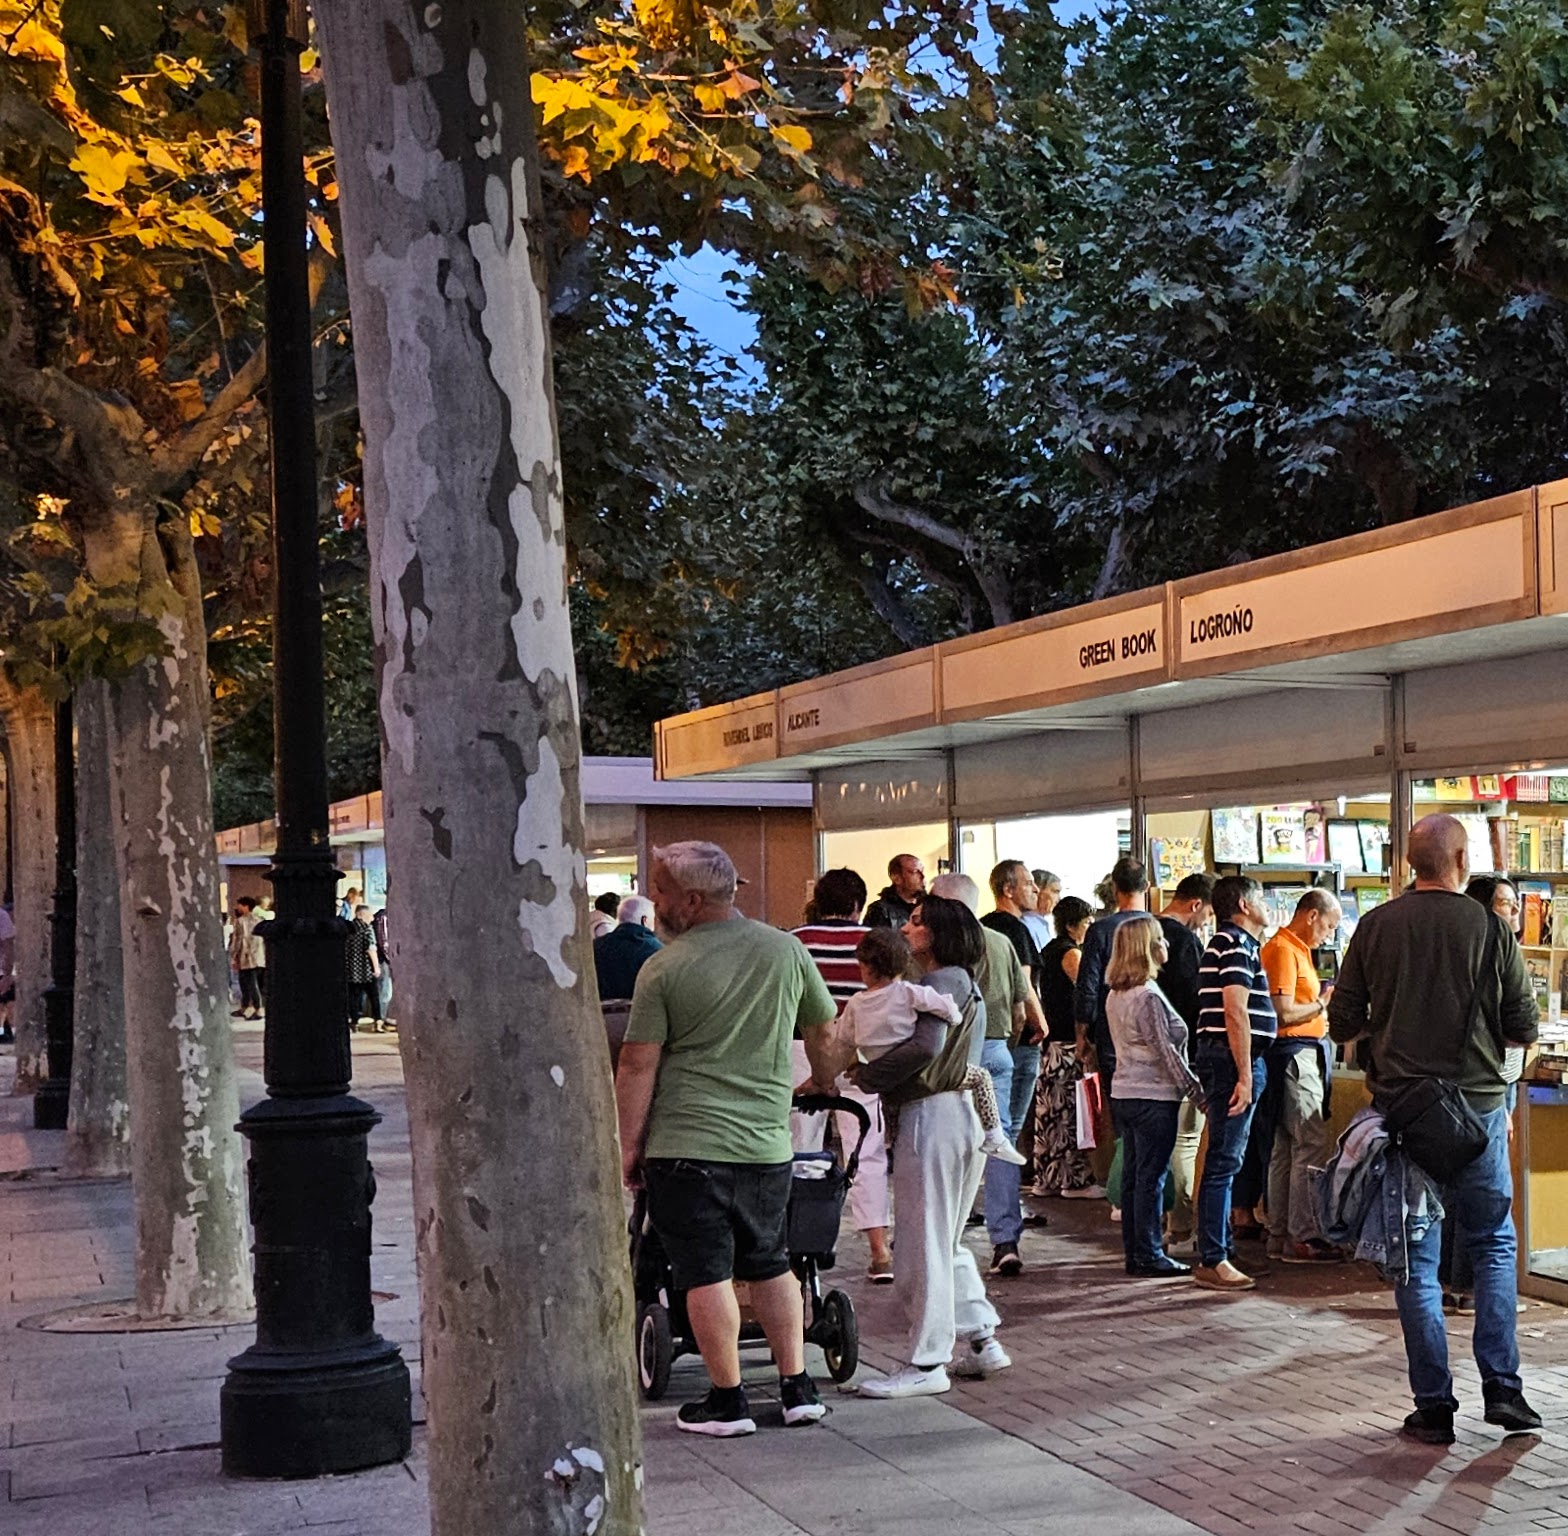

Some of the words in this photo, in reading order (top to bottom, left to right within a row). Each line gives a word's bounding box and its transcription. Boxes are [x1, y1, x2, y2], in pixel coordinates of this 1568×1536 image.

[1190, 604, 1254, 644] LOGROÑO
[1080, 639, 1115, 669] GREEN
[1122, 628, 1157, 660] BOOK
[786, 708, 821, 733] ALICANTE
